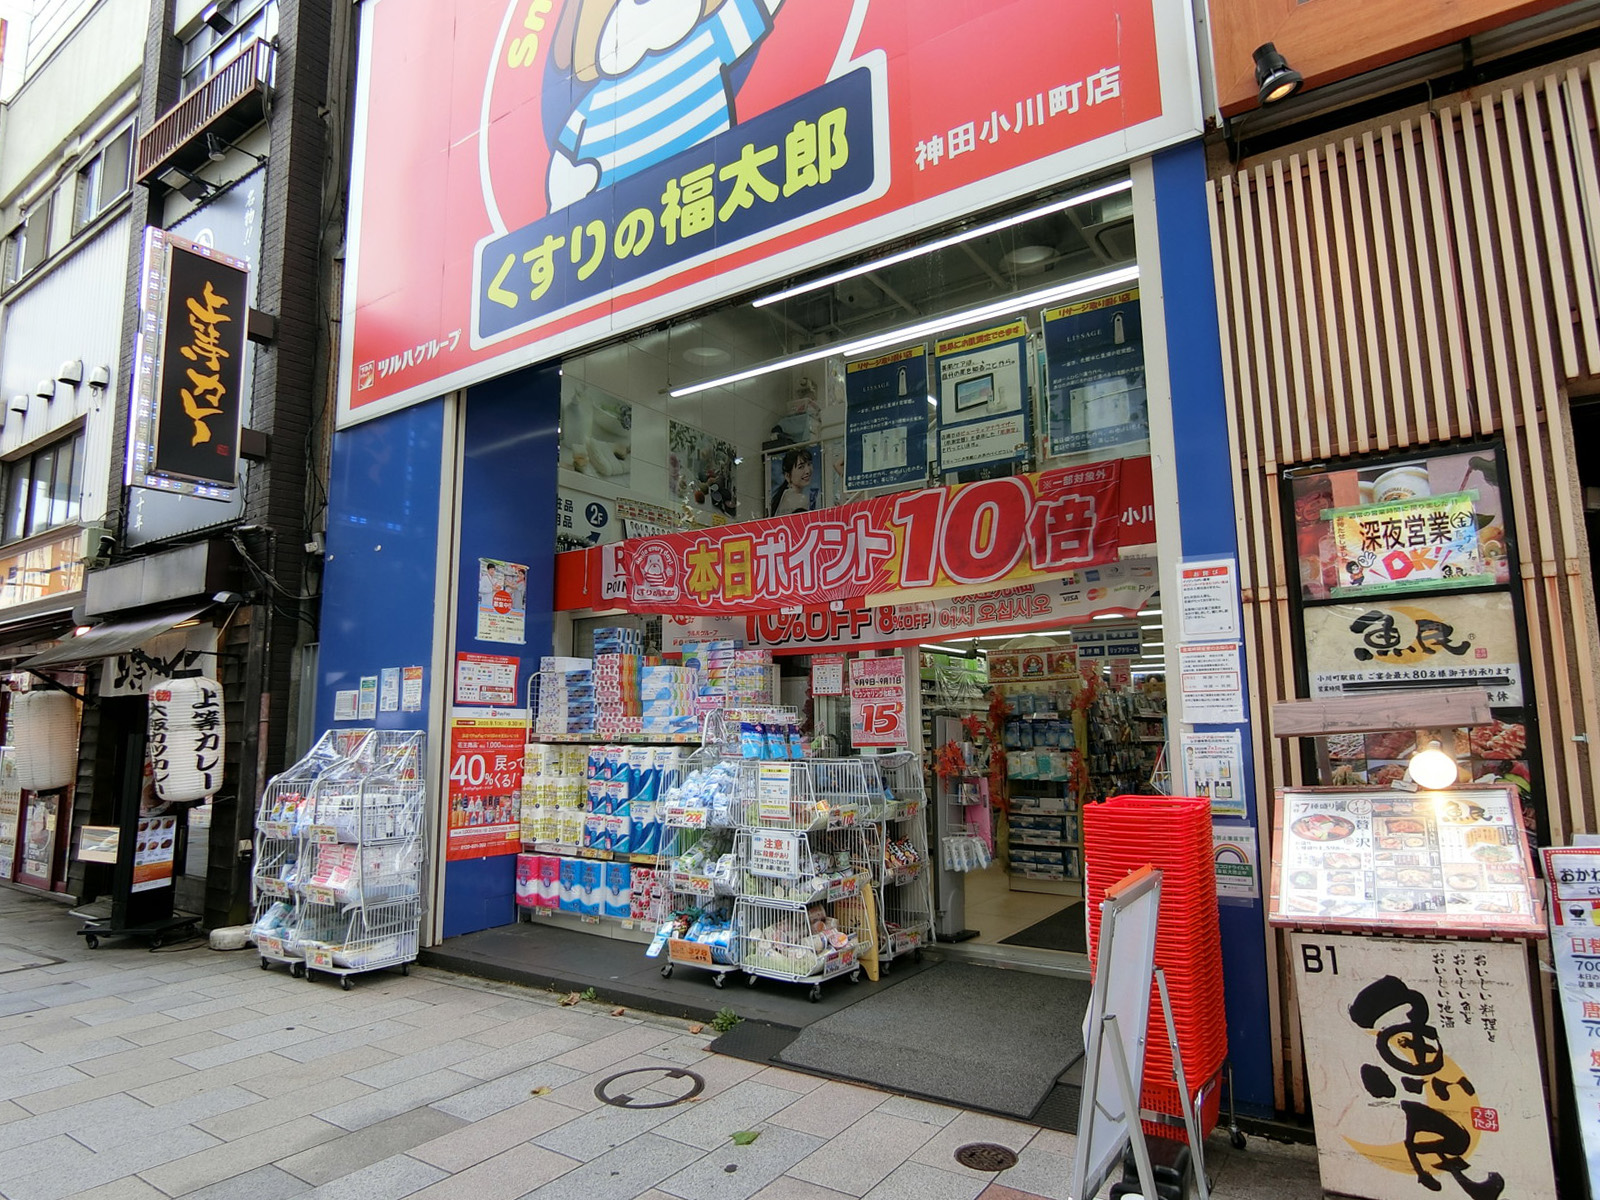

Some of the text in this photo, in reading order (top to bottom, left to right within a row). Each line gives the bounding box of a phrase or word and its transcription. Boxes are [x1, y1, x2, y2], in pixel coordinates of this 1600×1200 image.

[915, 65, 1121, 171] 神田小川町店
[487, 107, 849, 309] くすりの福太郎
[378, 328, 462, 379] ツルハグループ
[1066, 329, 1103, 343] LISSAGE
[590, 504, 603, 526] 2F
[1360, 511, 1452, 551] 深夜営業
[938, 594, 1052, 629] 어서 오십시오
[1062, 594, 1079, 602] VISA
[1350, 610, 1472, 661] 魚民
[1114, 673, 1129, 683] 15
[1317, 673, 1364, 682] 小川町駅前店
[192, 687, 220, 790] 上等カレー
[861, 702, 899, 736] 15
[150, 702, 170, 795] 大阪カツカレー
[494, 754, 525, 772] 戻って
[1301, 944, 1339, 975] B1
[1432, 953, 1455, 1029] おいしい地酒
[1453, 954, 1475, 1025] おいしい魚と
[1474, 955, 1497, 1043] おいしい料理と
[1349, 975, 1505, 1200] 魚民
